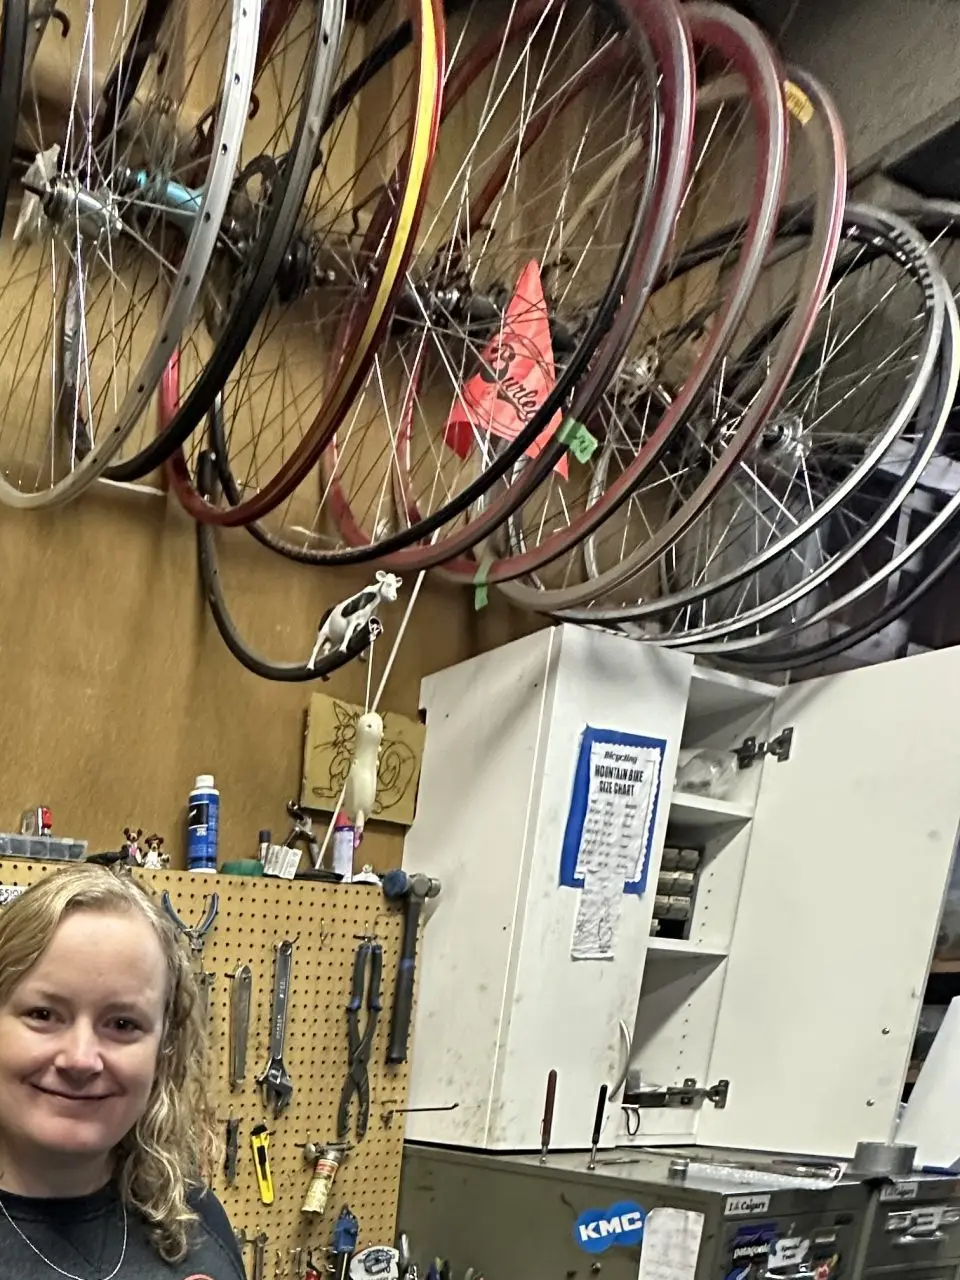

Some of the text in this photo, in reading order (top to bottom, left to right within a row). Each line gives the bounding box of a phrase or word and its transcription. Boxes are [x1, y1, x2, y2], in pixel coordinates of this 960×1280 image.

[478, 342, 540, 426] Burle
[603, 750, 638, 764] Bicycling
[594, 763, 644, 783] MOUNTAIN BIKE
[599, 780, 635, 797] SIZE CHART
[578, 1211, 643, 1241] KMC
